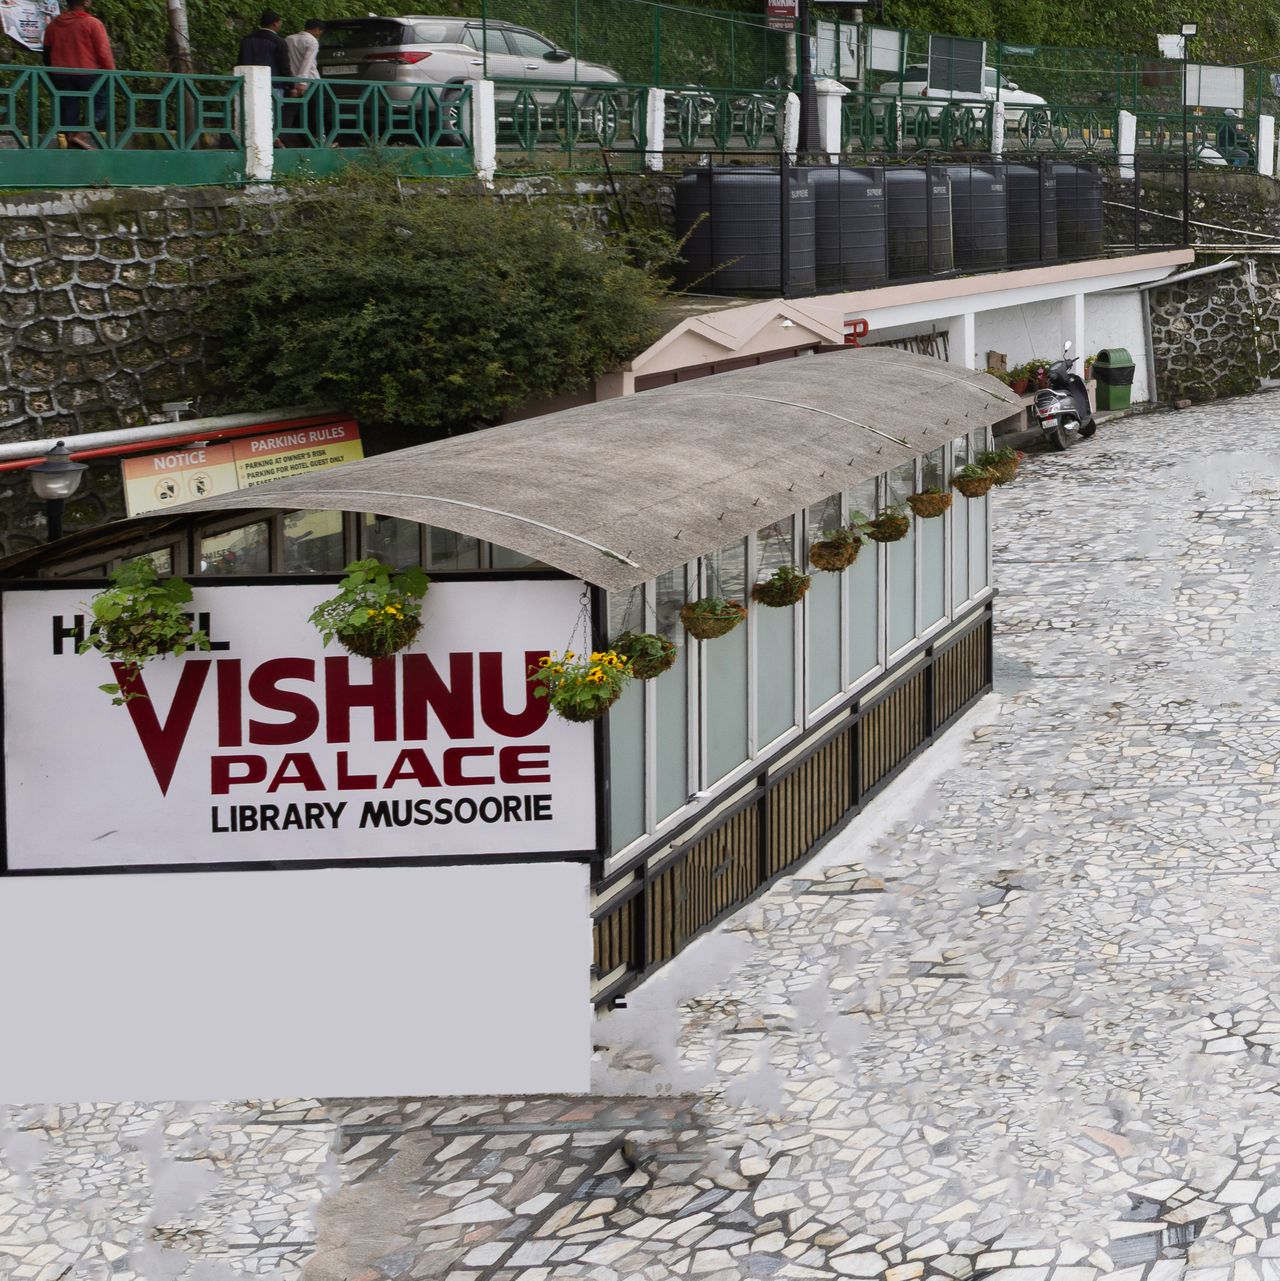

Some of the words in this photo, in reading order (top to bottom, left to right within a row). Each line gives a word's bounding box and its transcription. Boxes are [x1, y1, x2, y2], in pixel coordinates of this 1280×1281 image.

[251, 432, 306, 452] PARKING
[309, 426, 345, 442] RULES
[153, 450, 207, 471] NOTICE
[245, 459, 274, 469] PARKING
[283, 451, 311, 463] OWNER'S
[312, 449, 327, 457] RISK
[247, 468, 276, 479] PARKING
[290, 463, 309, 471] HOTEL
[310, 458, 329, 467] GUEST
[329, 455, 345, 463] ONLY
[110, 650, 552, 798] VISHNU
[211, 745, 552, 795] PALACE
[211, 800, 347, 834] LIBRARY
[359, 793, 553, 829] MUSSOORIE
